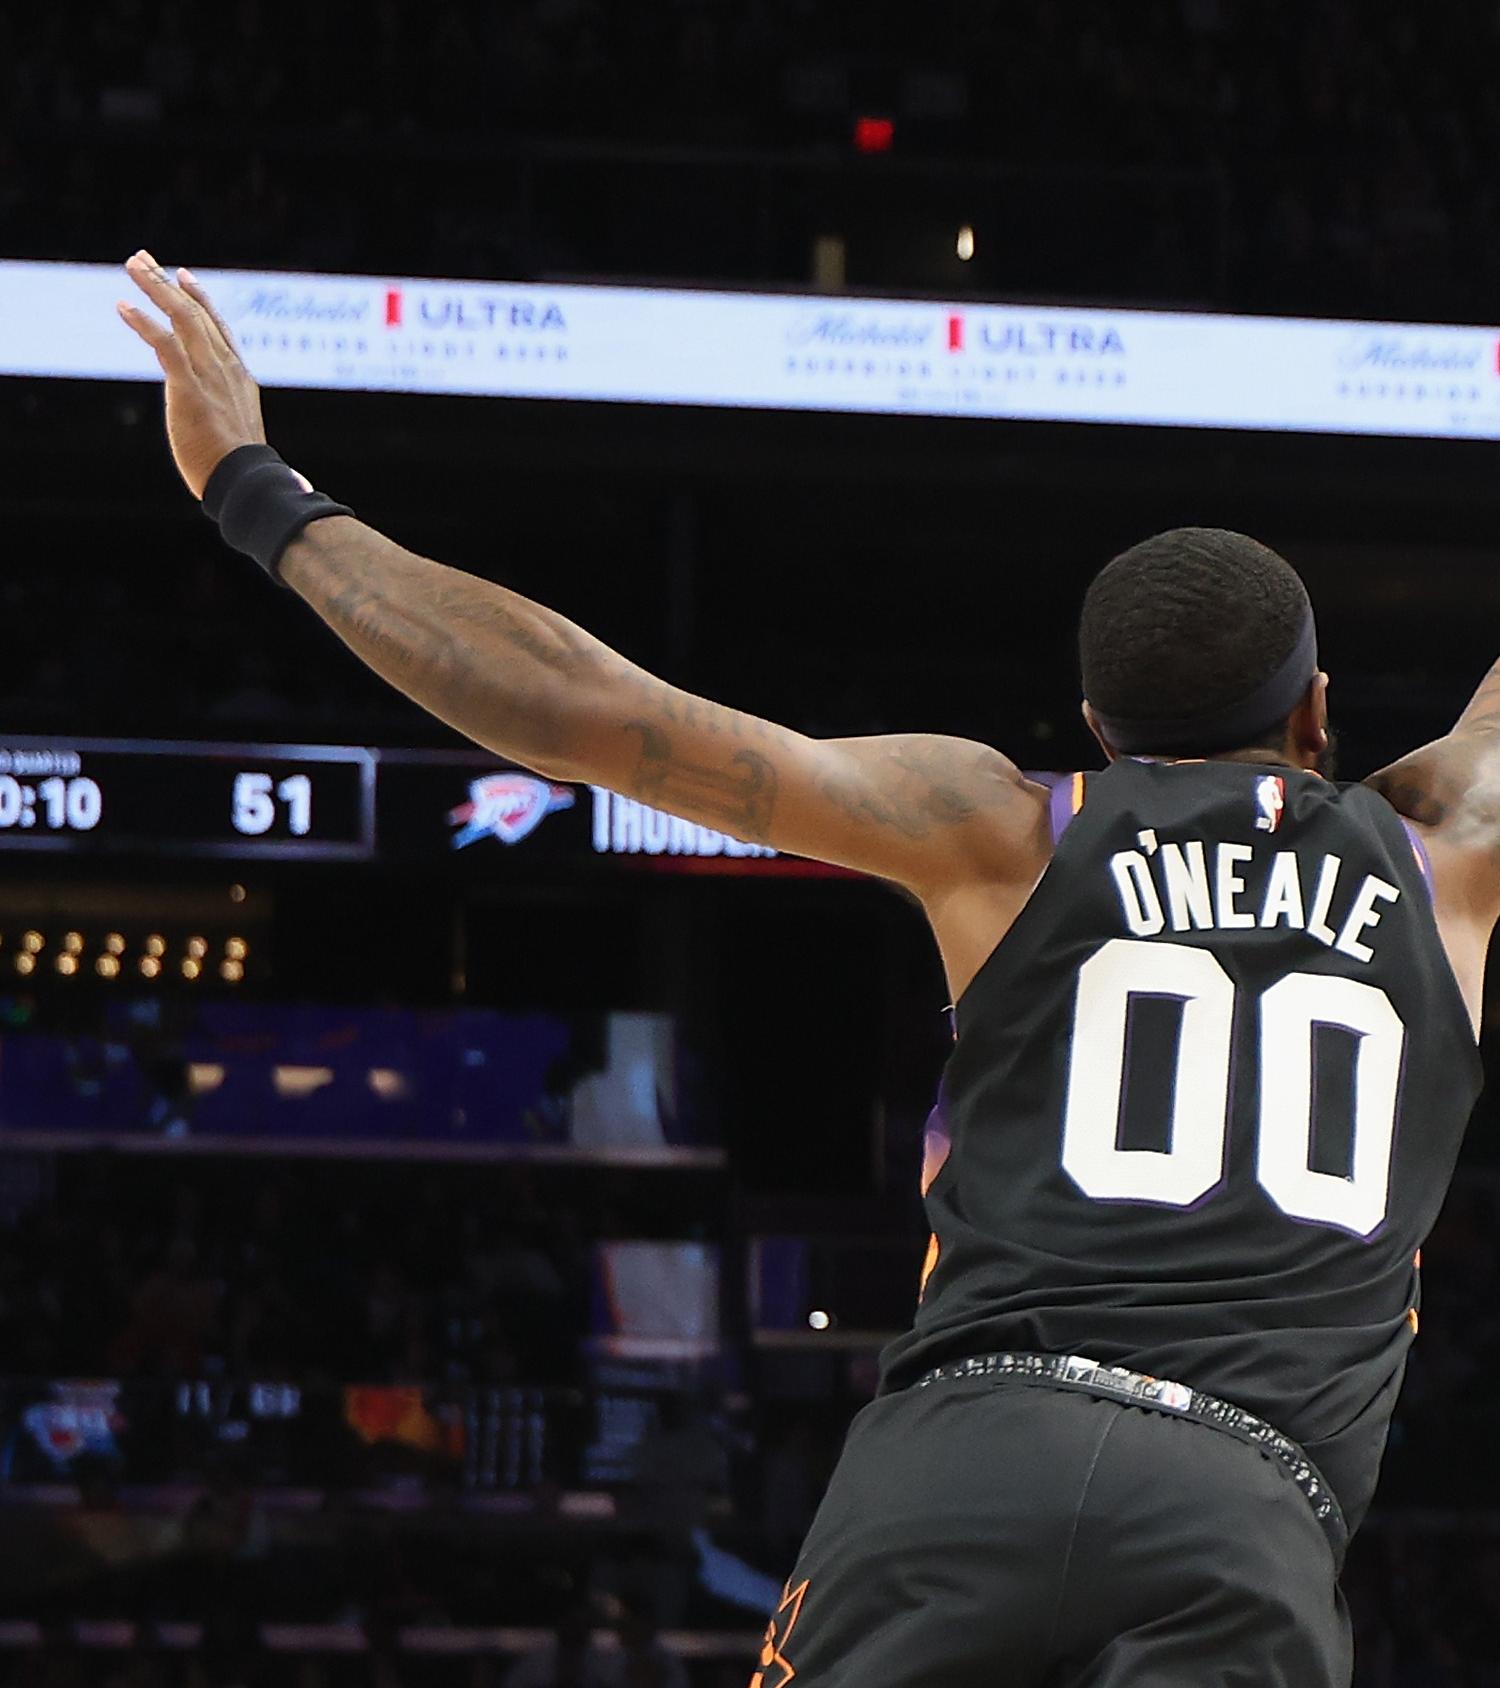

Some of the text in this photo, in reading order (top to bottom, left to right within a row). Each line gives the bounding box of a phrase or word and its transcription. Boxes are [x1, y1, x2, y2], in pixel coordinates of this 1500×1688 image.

[418, 297, 567, 331] ULTRA
[979, 322, 1126, 356] ULTRA
[231, 772, 312, 835] 51
[1110, 829, 1400, 963] O'NEALE
[1061, 939, 1405, 1241] 00
